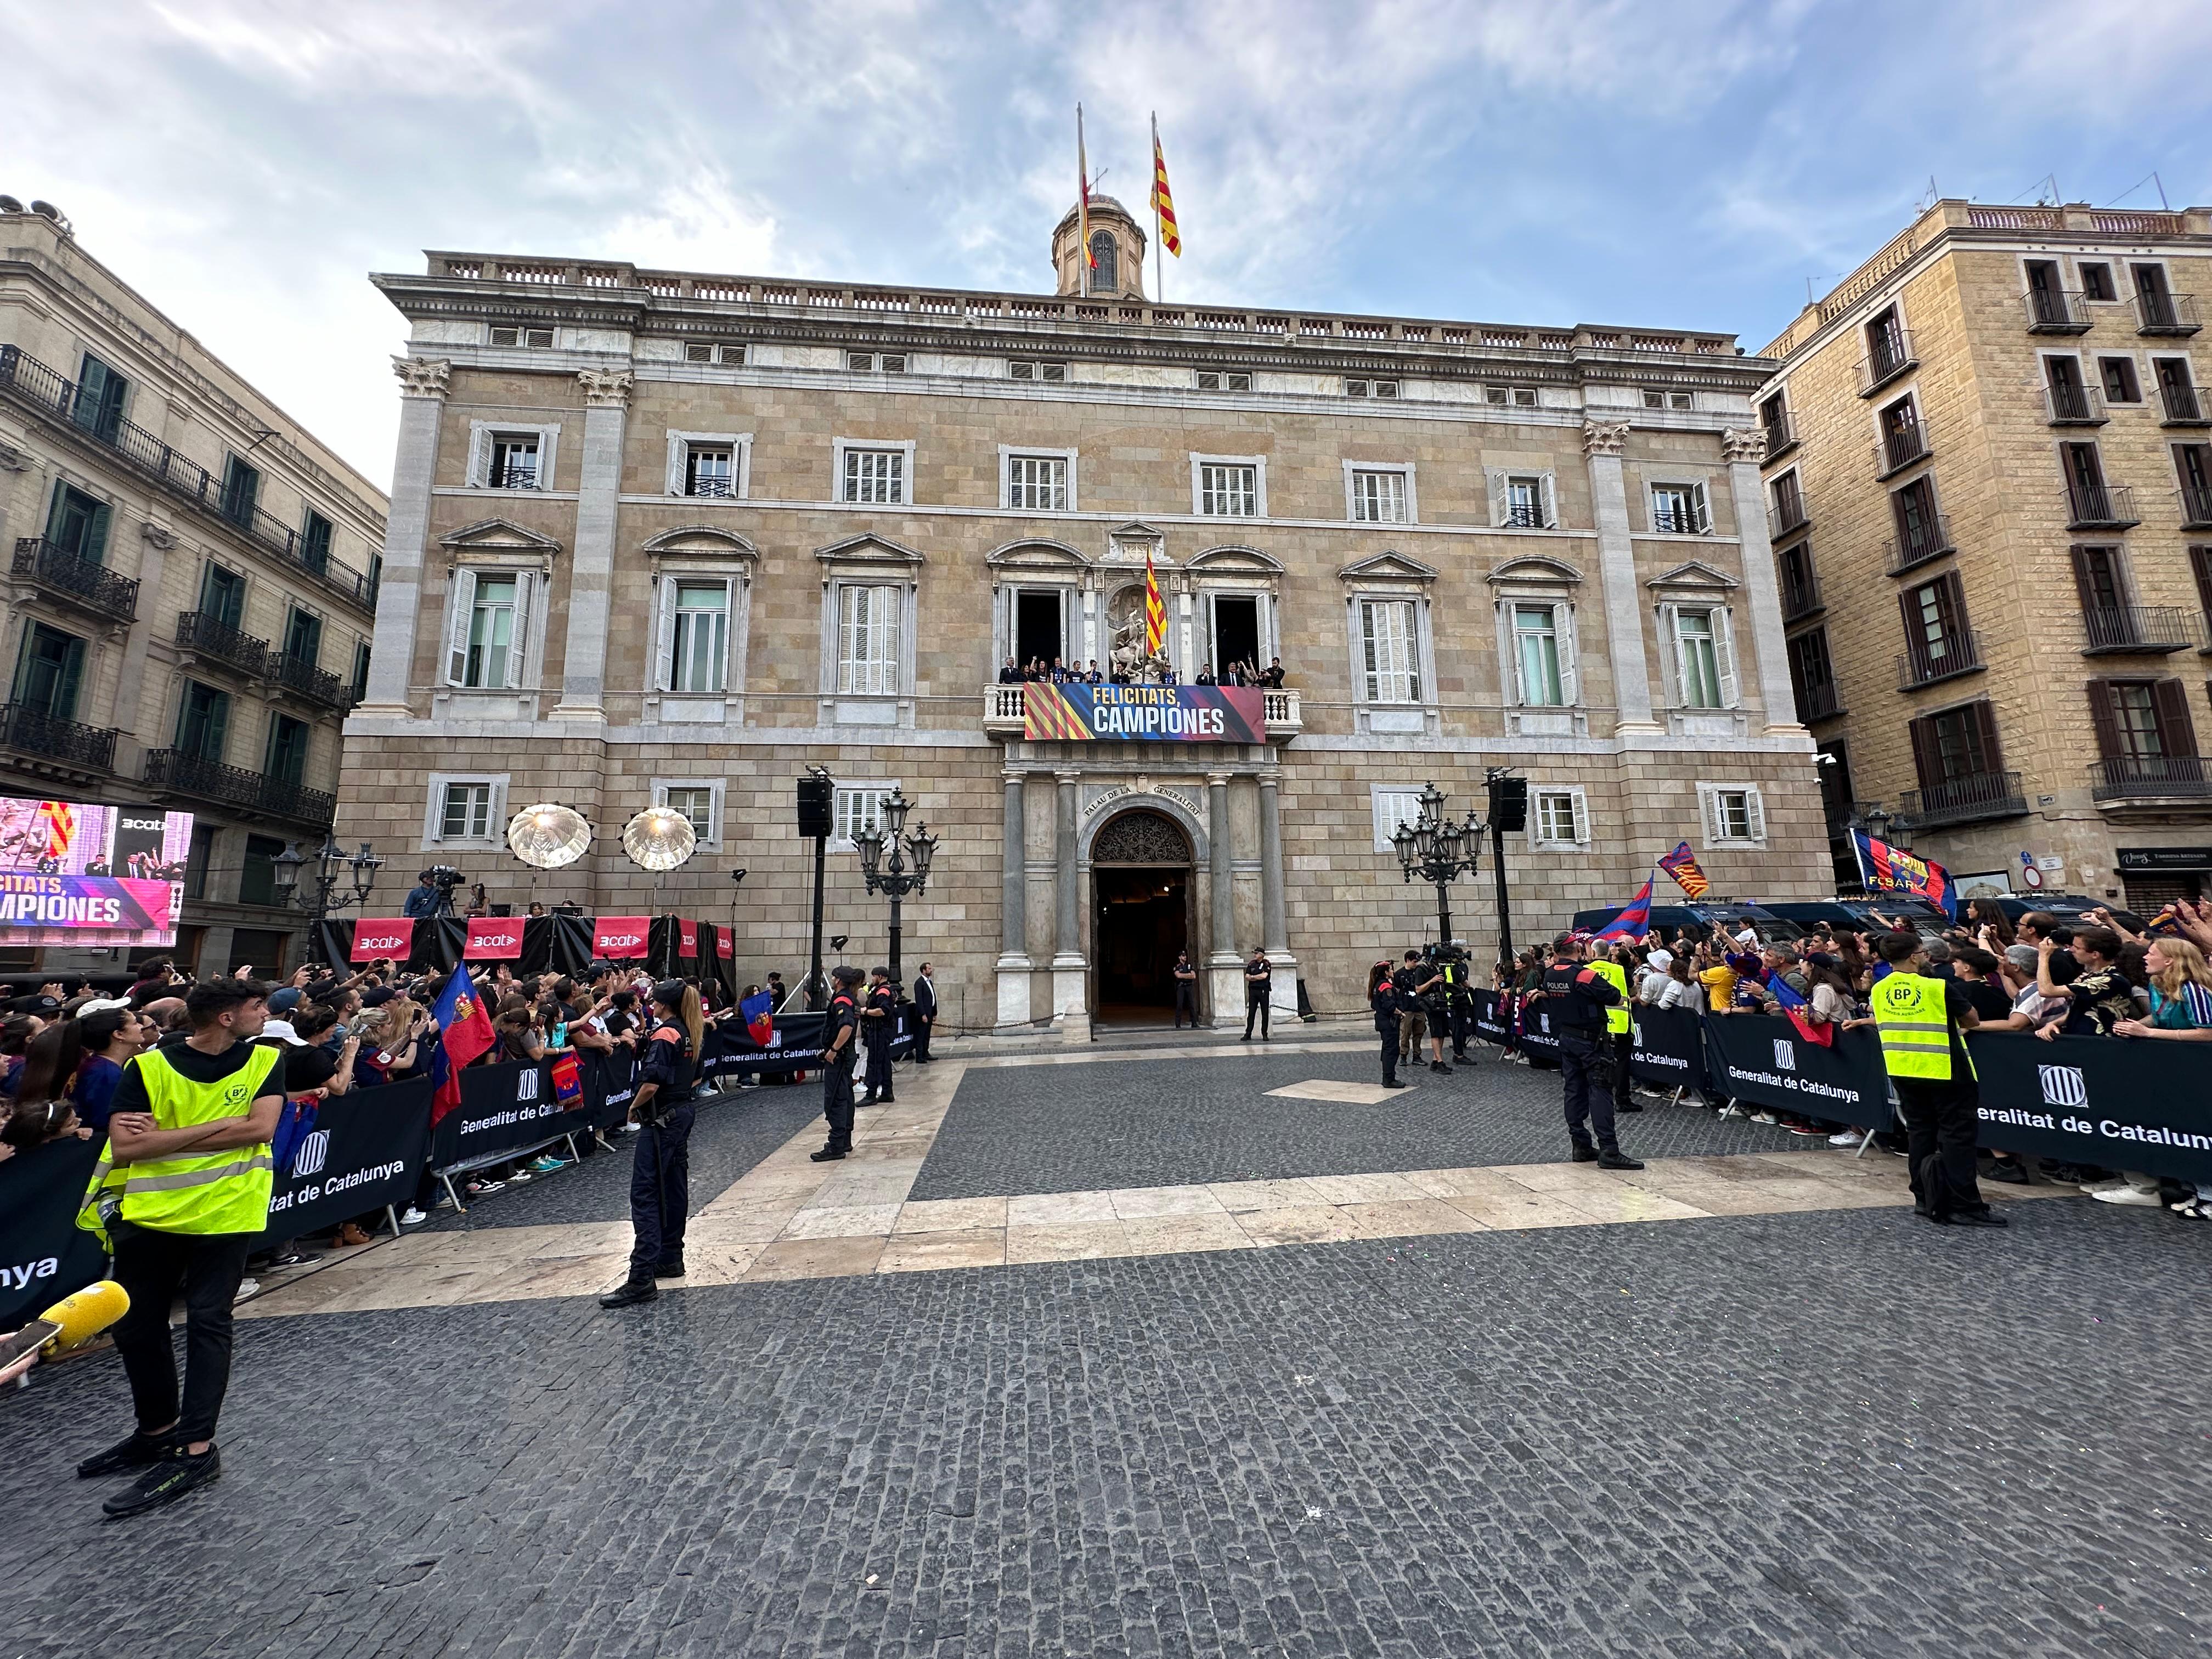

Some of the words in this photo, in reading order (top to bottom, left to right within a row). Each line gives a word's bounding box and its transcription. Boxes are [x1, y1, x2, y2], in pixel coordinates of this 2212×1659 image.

[1093, 687, 1180, 708] FELICITATS,
[1093, 706, 1224, 734] CAMPIONES
[1084, 795, 1107, 816] PALAU
[1108, 790, 1119, 799] DE
[1154, 786, 1201, 816] GENERALITAT
[122, 818, 163, 831] 3cat
[360, 936, 394, 949] 3cat
[473, 934, 506, 947] 3cat
[600, 934, 632, 947] 3cat
[1894, 989, 1911, 1000] BP
[1514, 1001, 1519, 1018] 5
[721, 1052, 767, 1062] eneralitat
[769, 1051, 781, 1059] de
[1635, 1051, 1645, 1062] de
[1646, 1052, 1688, 1070] Catalunya
[1729, 1065, 1782, 1087] Generalitat
[1784, 1076, 1798, 1090] de
[1800, 1078, 1859, 1103] Catalunya
[520, 1107, 536, 1120] de
[2061, 1116, 2093, 1135] de
[298, 1184, 320, 1204] de
[325, 1160, 404, 1195] Catalunya
